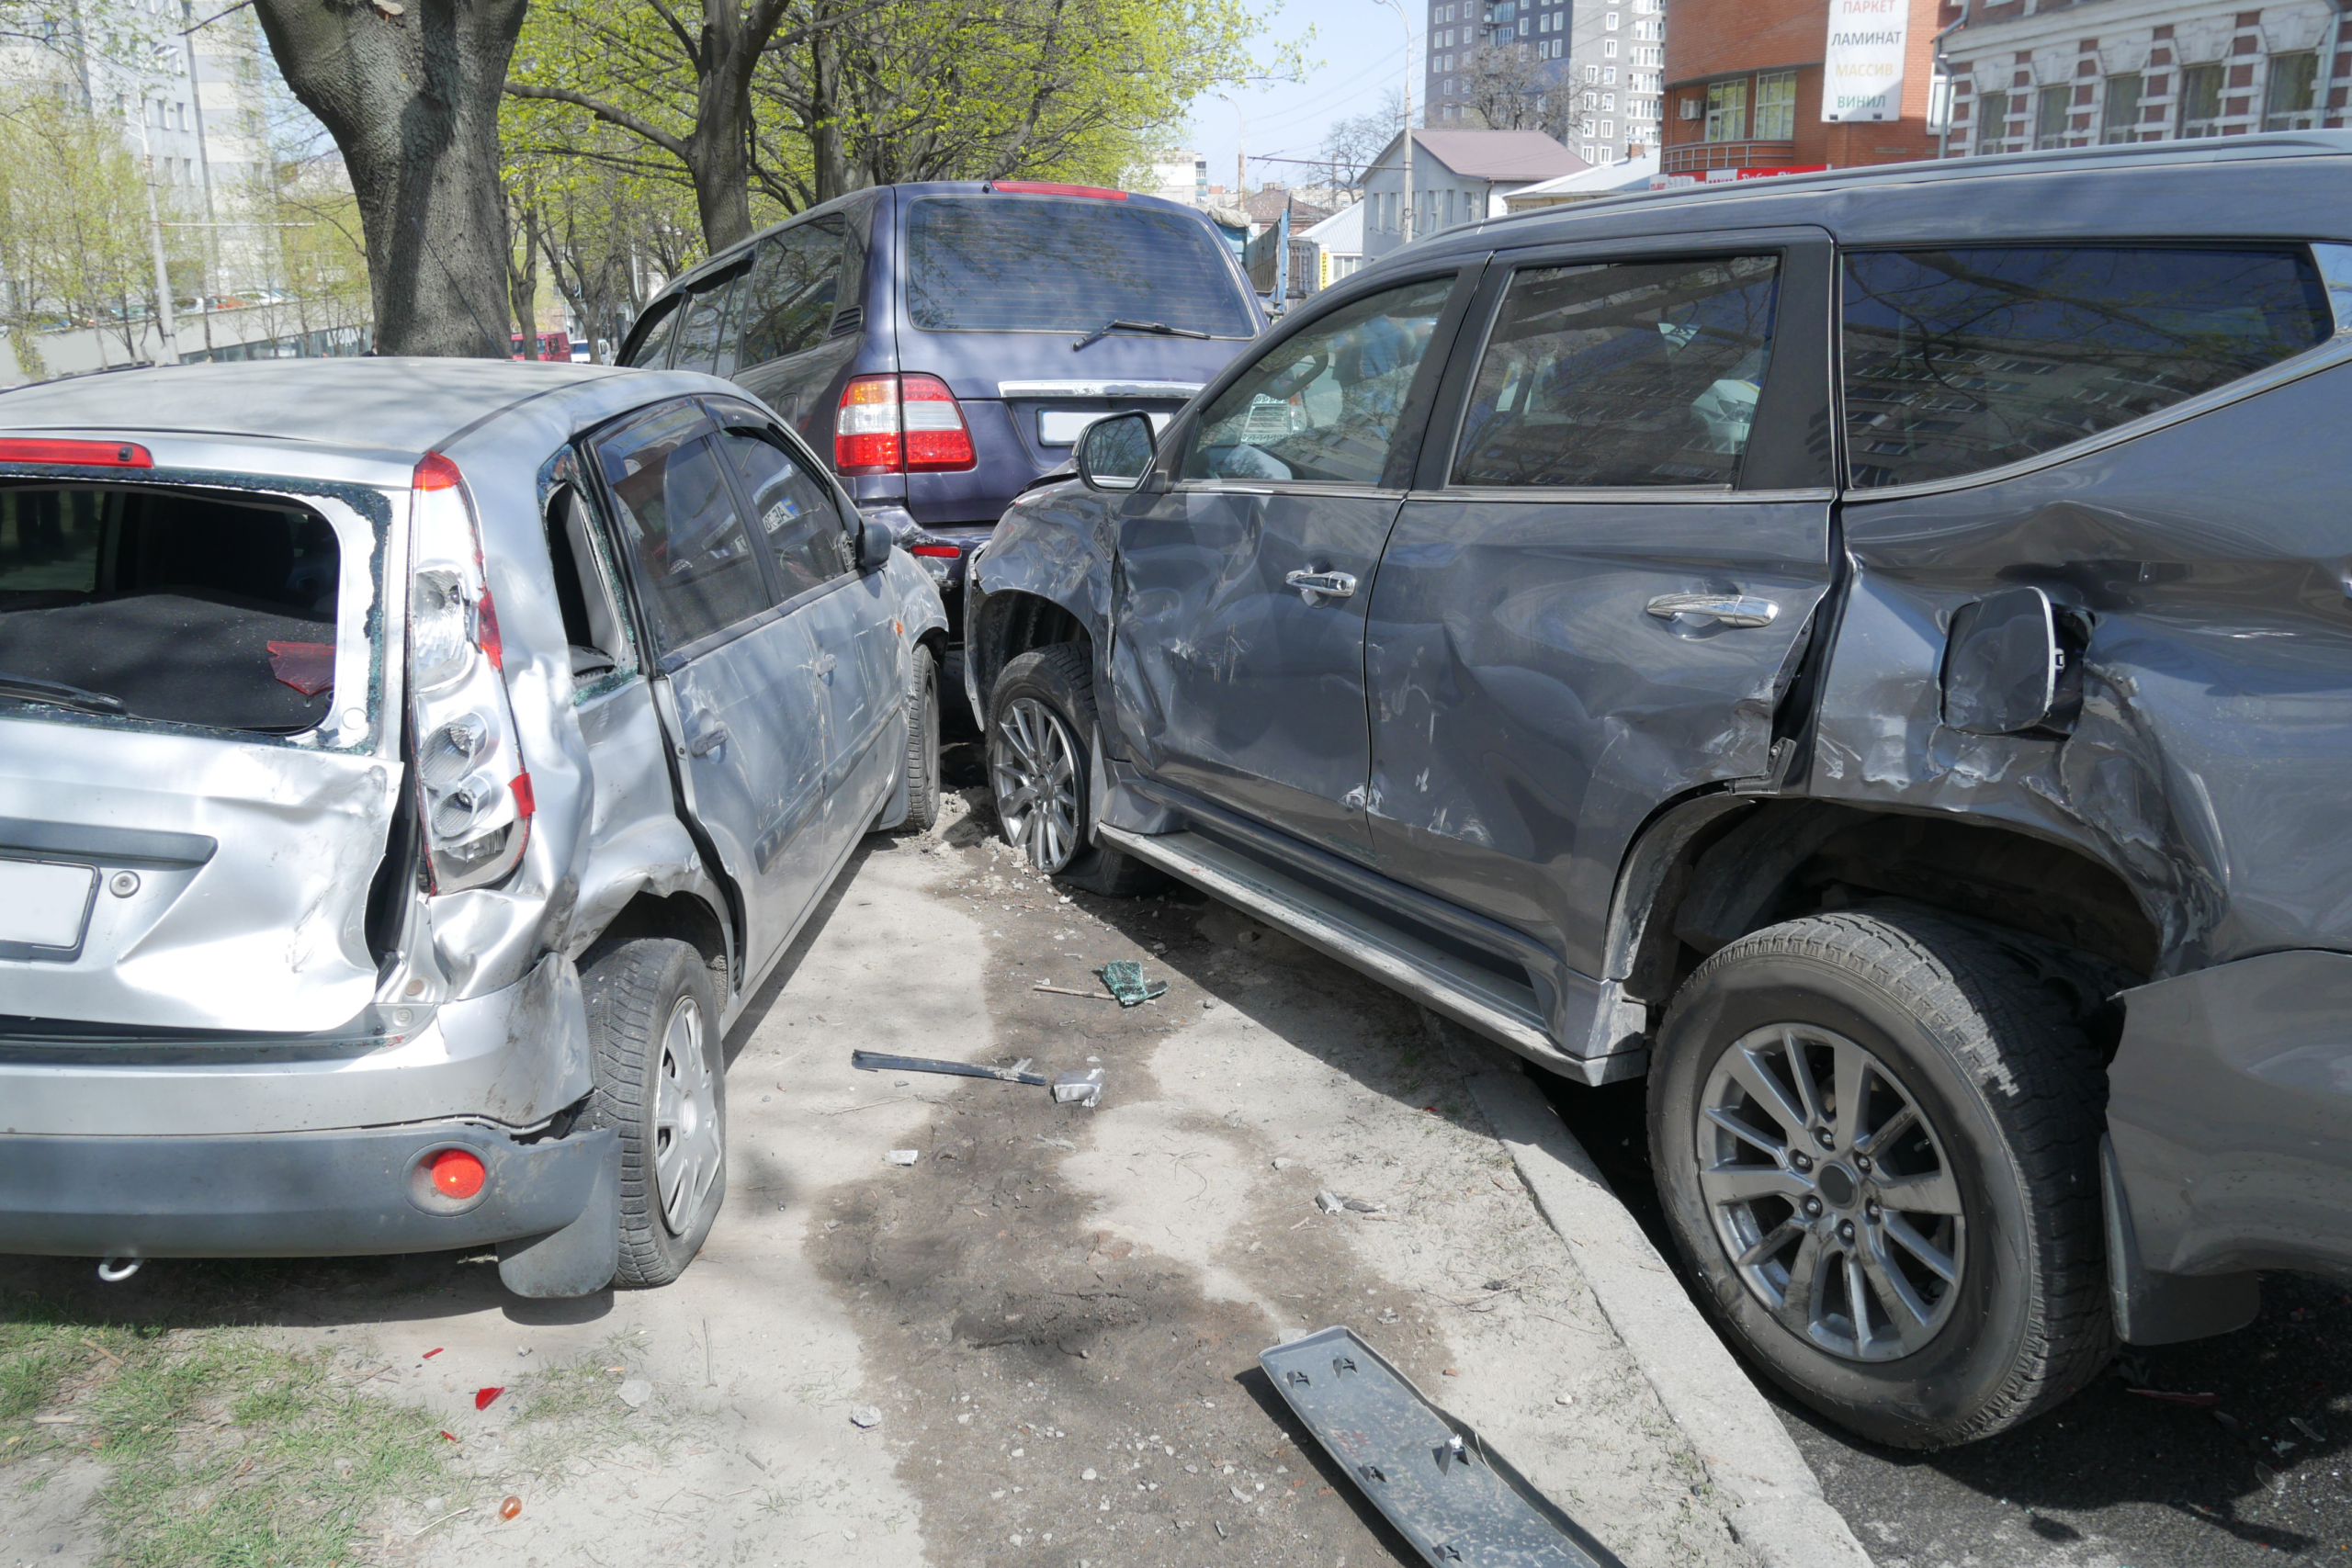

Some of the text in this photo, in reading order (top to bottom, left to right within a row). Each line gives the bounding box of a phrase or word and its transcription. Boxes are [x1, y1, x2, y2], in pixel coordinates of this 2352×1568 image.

[1843, 0, 1895, 14] ПАРКЕТ
[1831, 31, 1902, 46] ЛАМИНАТ
[1836, 63, 1894, 76] МАССИВ
[1838, 95, 1885, 108] ВИНИЛ
